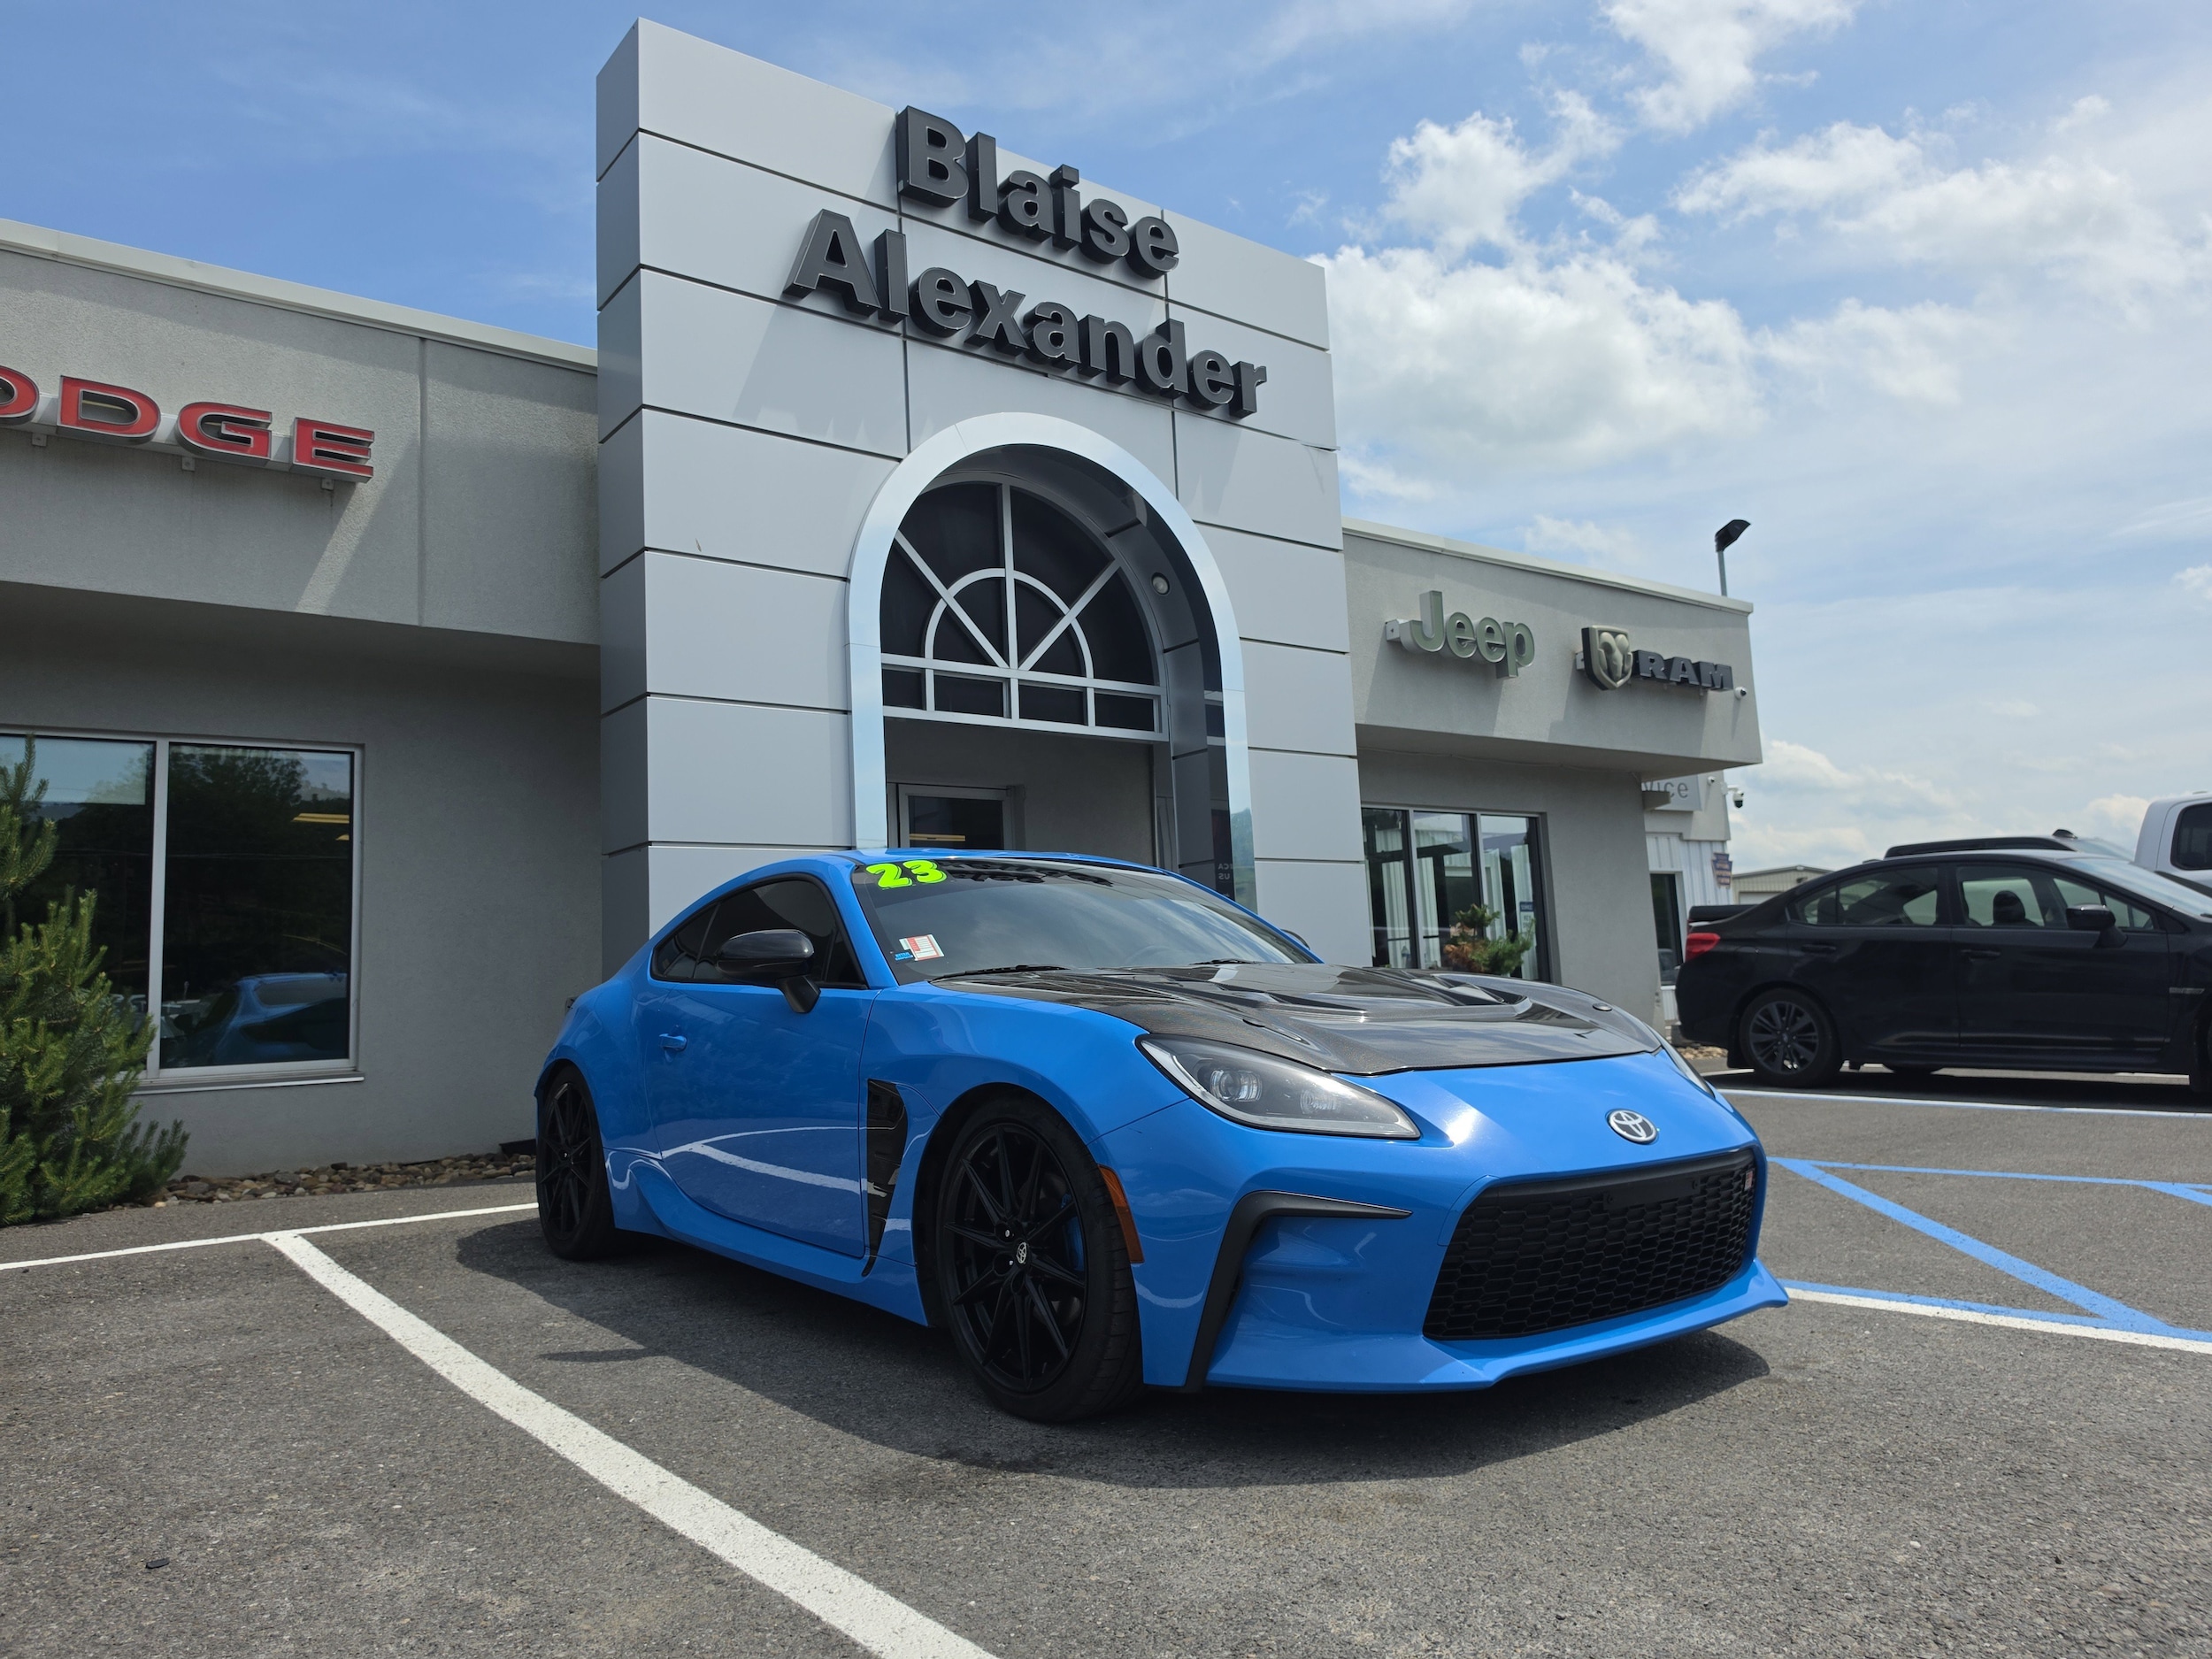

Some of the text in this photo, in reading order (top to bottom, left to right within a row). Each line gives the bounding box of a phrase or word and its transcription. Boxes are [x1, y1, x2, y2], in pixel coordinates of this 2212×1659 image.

[895, 105, 1179, 280] Blaise
[782, 209, 1267, 419] Alexander
[1402, 590, 1535, 679] Jeep
[1634, 649, 1733, 690] RAM
[866, 860, 947, 890] 23
